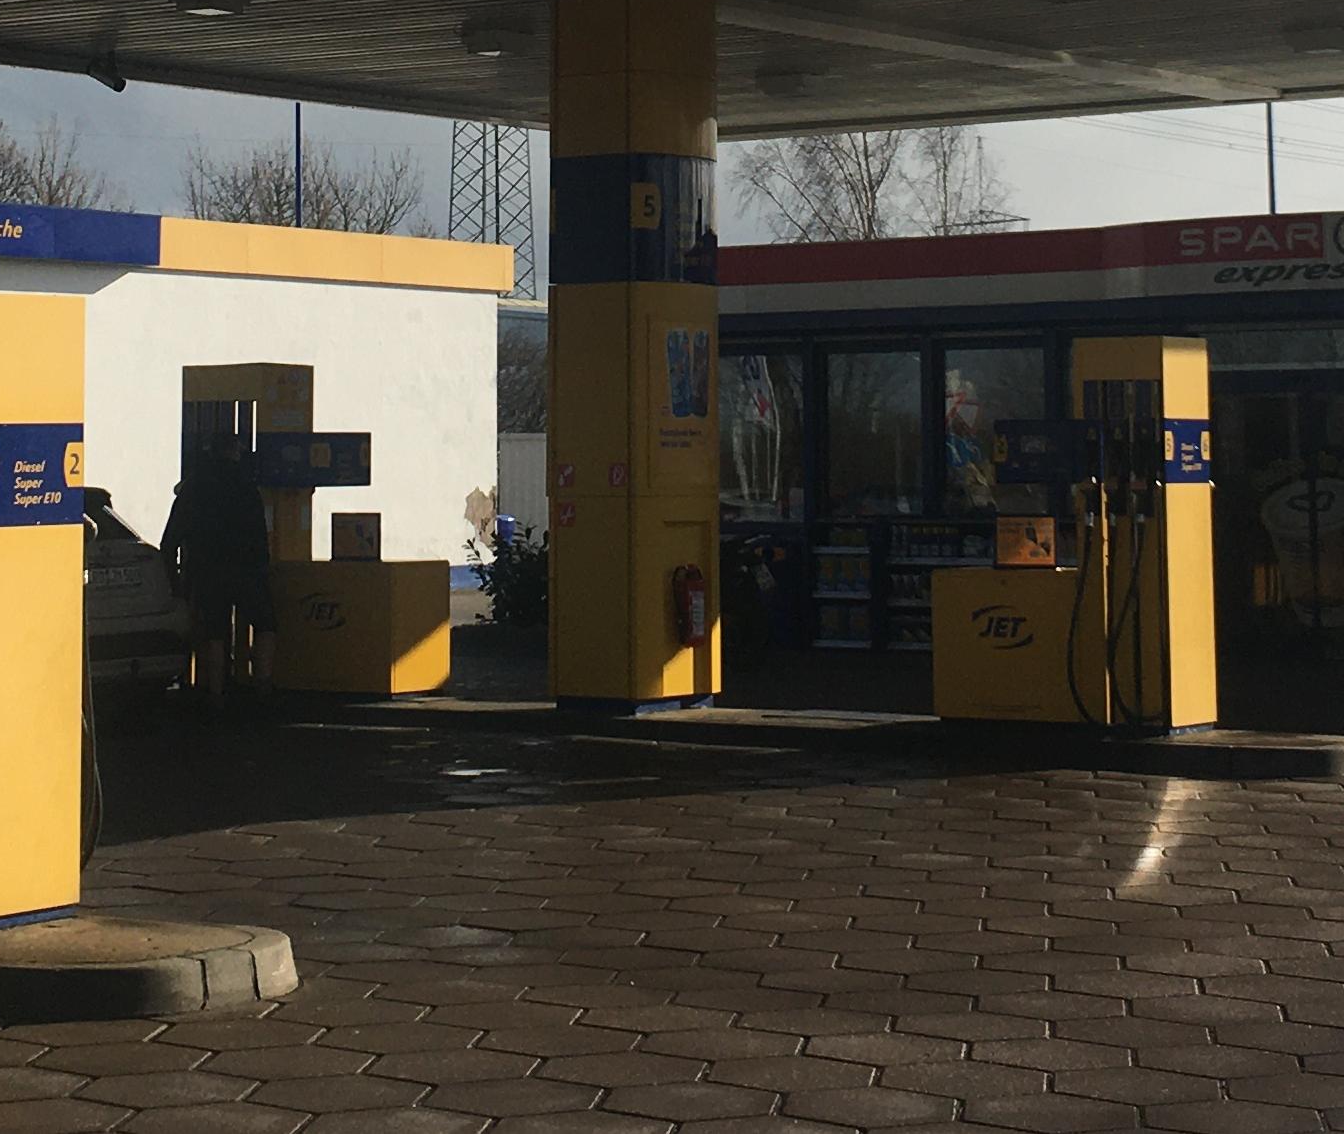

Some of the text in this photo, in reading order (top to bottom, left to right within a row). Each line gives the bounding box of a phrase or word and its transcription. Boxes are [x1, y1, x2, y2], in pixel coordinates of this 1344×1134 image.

[643, 194, 656, 217] 5
[1179, 223, 1319, 255] SPAR
[14, 460, 46, 473] Diesel
[69, 453, 80, 475] 2
[13, 477, 43, 492] Super
[13, 491, 62, 507] Super E10
[979, 617, 1026, 637] JET
